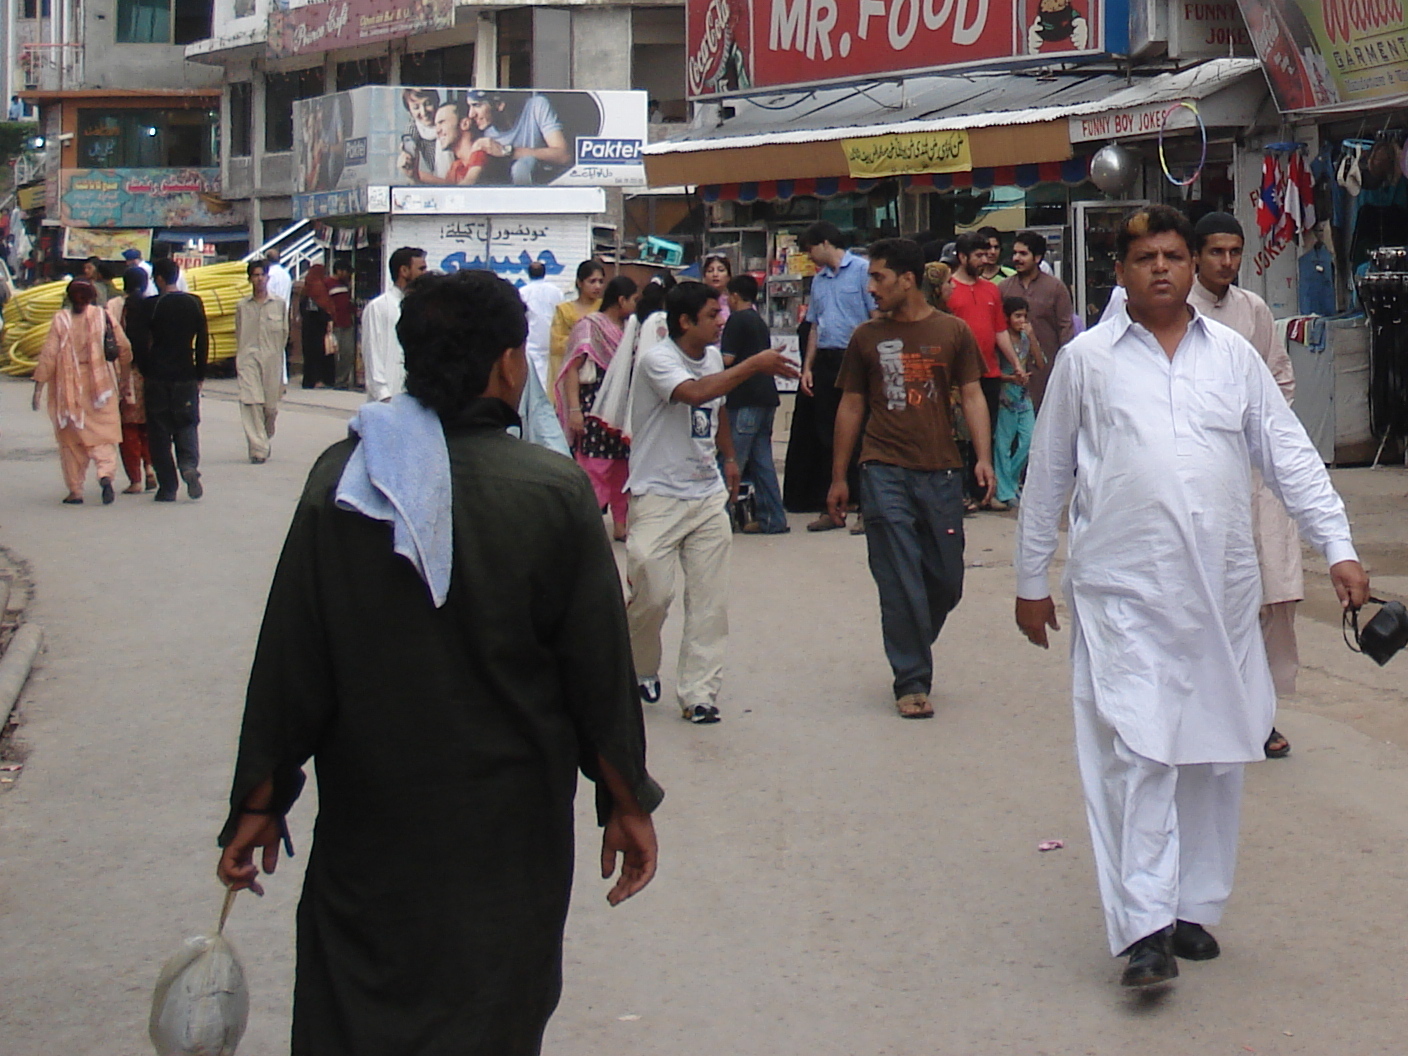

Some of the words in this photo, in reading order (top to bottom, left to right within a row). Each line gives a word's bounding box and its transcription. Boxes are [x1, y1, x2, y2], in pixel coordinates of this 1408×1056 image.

[1185, 4, 1237, 20] FUNNY
[1082, 117, 1111, 137] FUNNY
[1115, 113, 1133, 134] BOY
[1138, 109, 1167, 130] JOKES
[581, 140, 640, 158] Paktel
